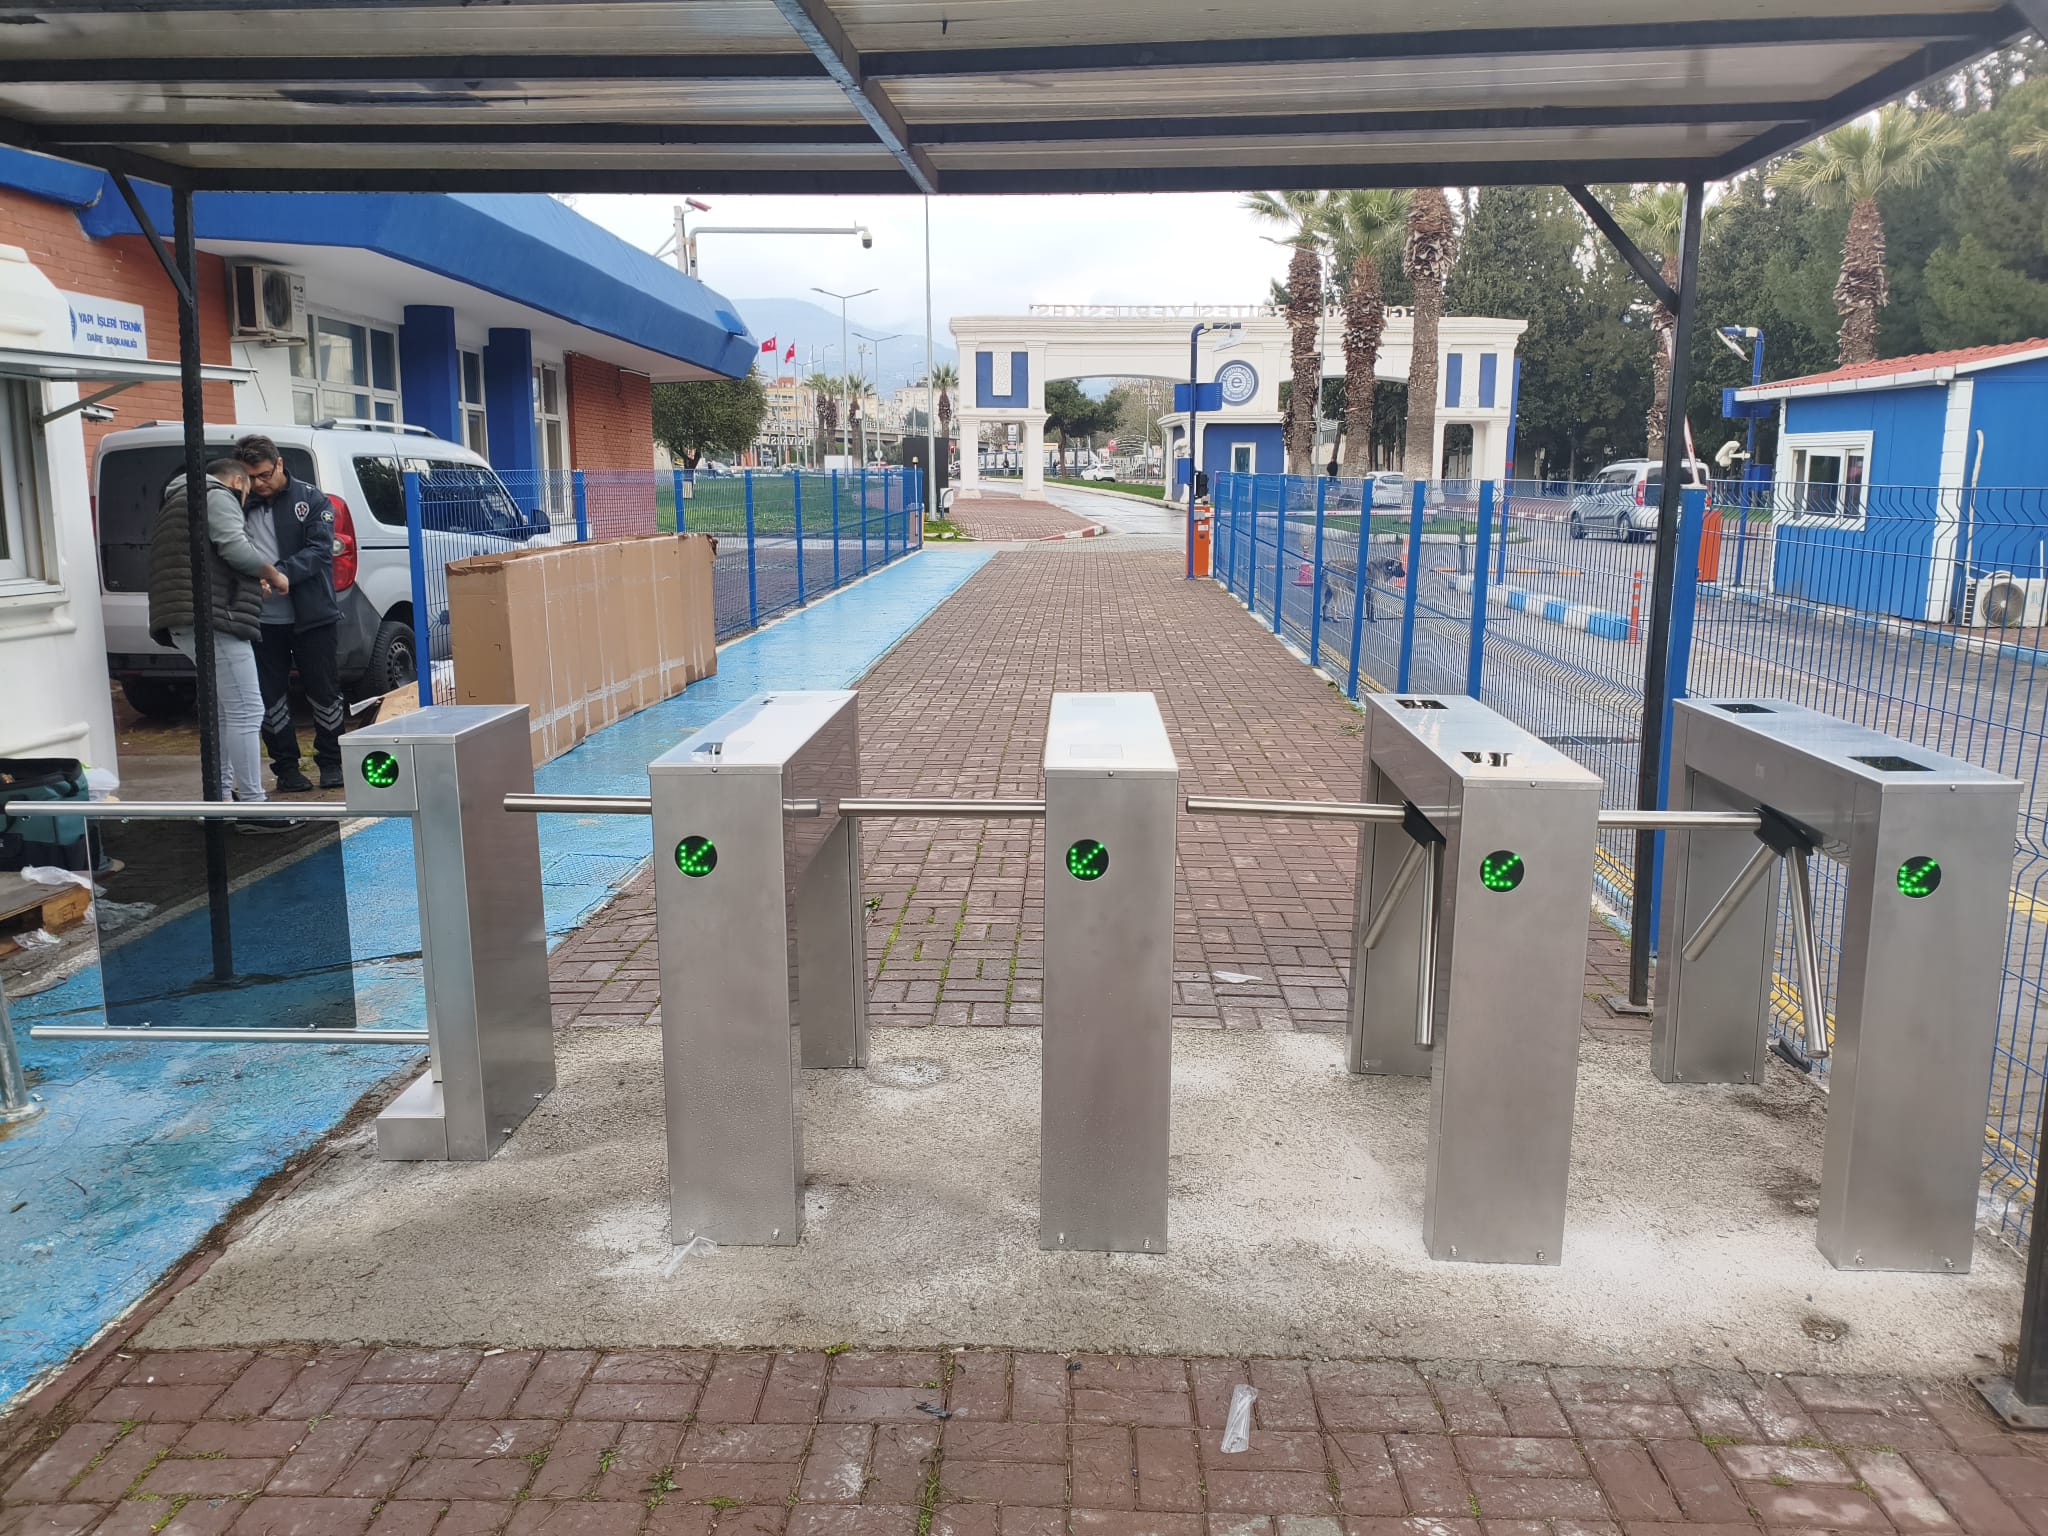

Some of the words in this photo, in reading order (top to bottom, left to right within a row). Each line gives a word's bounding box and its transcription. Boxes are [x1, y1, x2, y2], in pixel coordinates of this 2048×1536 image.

[78, 312, 94, 325] YAPI
[97, 313, 117, 329] İŞLERİ
[119, 319, 142, 333] TEKNİK
[87, 332, 104, 344] DAİRE
